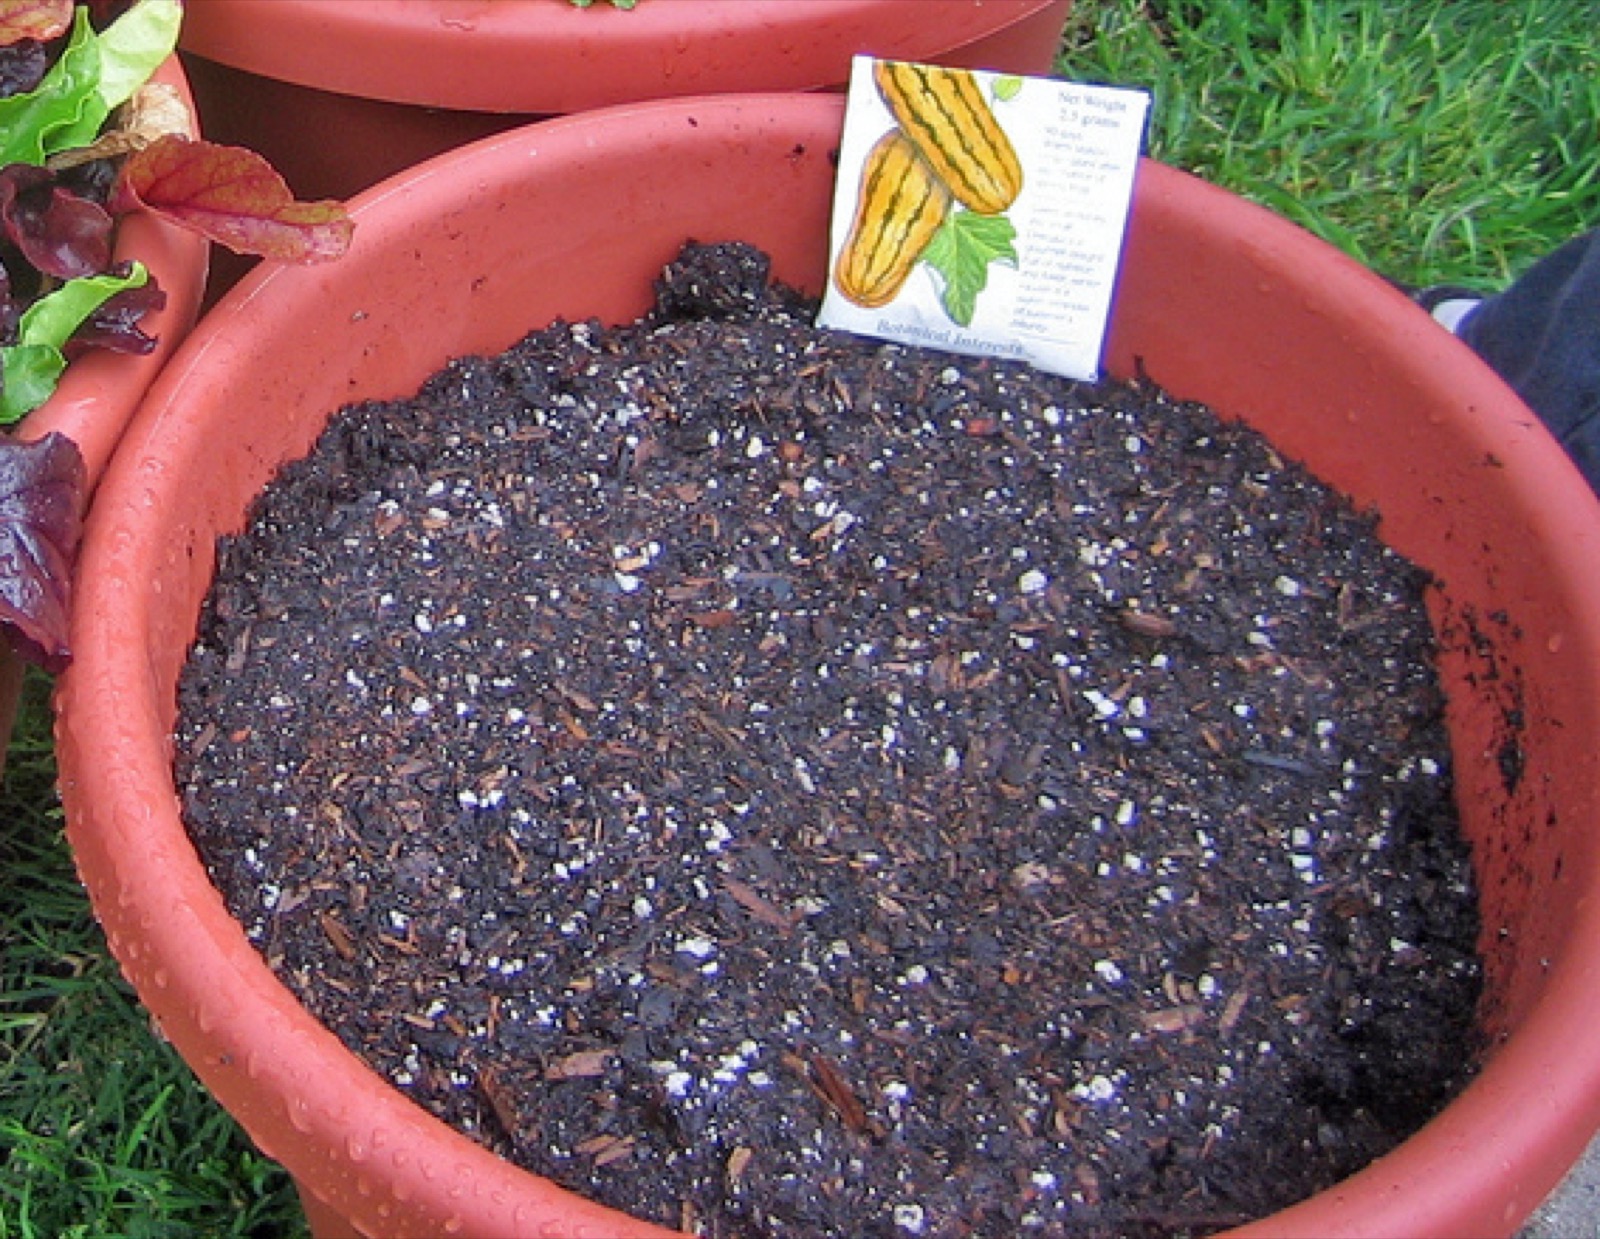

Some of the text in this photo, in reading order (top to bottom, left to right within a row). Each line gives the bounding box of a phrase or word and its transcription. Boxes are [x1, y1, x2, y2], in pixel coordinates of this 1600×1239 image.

[1083, 95, 1126, 112] Weight
[1080, 115, 1120, 128] grams
[877, 319, 1024, 355] Botanical Interests
